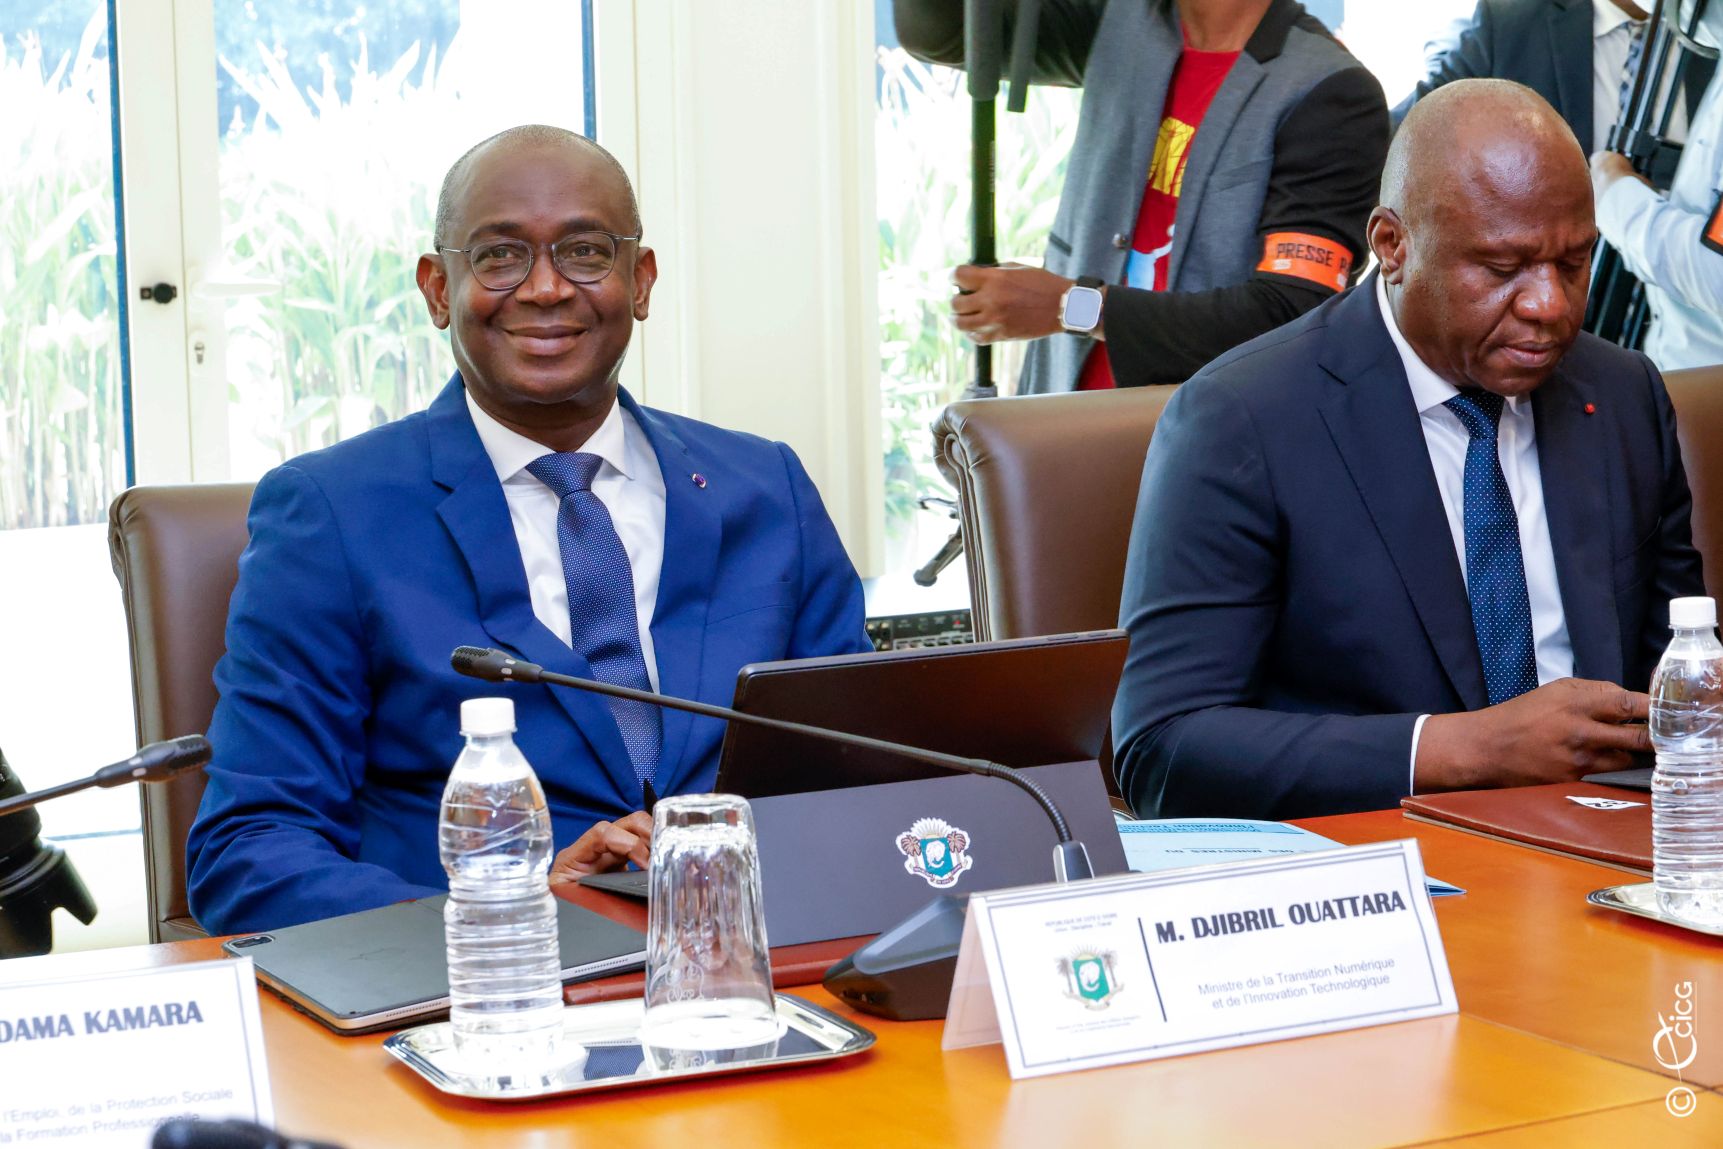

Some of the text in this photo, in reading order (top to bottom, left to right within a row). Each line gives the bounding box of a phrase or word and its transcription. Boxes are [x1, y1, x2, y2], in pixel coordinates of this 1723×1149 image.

[1277, 243, 1334, 266] PRESSE
[1155, 891, 1407, 944] M. DJIBRIL OUATTARA
[1198, 957, 1395, 995] Ministre de la Transition Numérique
[1212, 974, 1391, 1009] et de l'Innovation Technologique
[84, 1001, 204, 1034] KAMARA
[68, 1105, 85, 1117] de
[90, 1102, 102, 1114] la
[107, 1094, 177, 1111] Protection
[182, 1087, 233, 1104] Sociale
[17, 1125, 88, 1141] Formation
